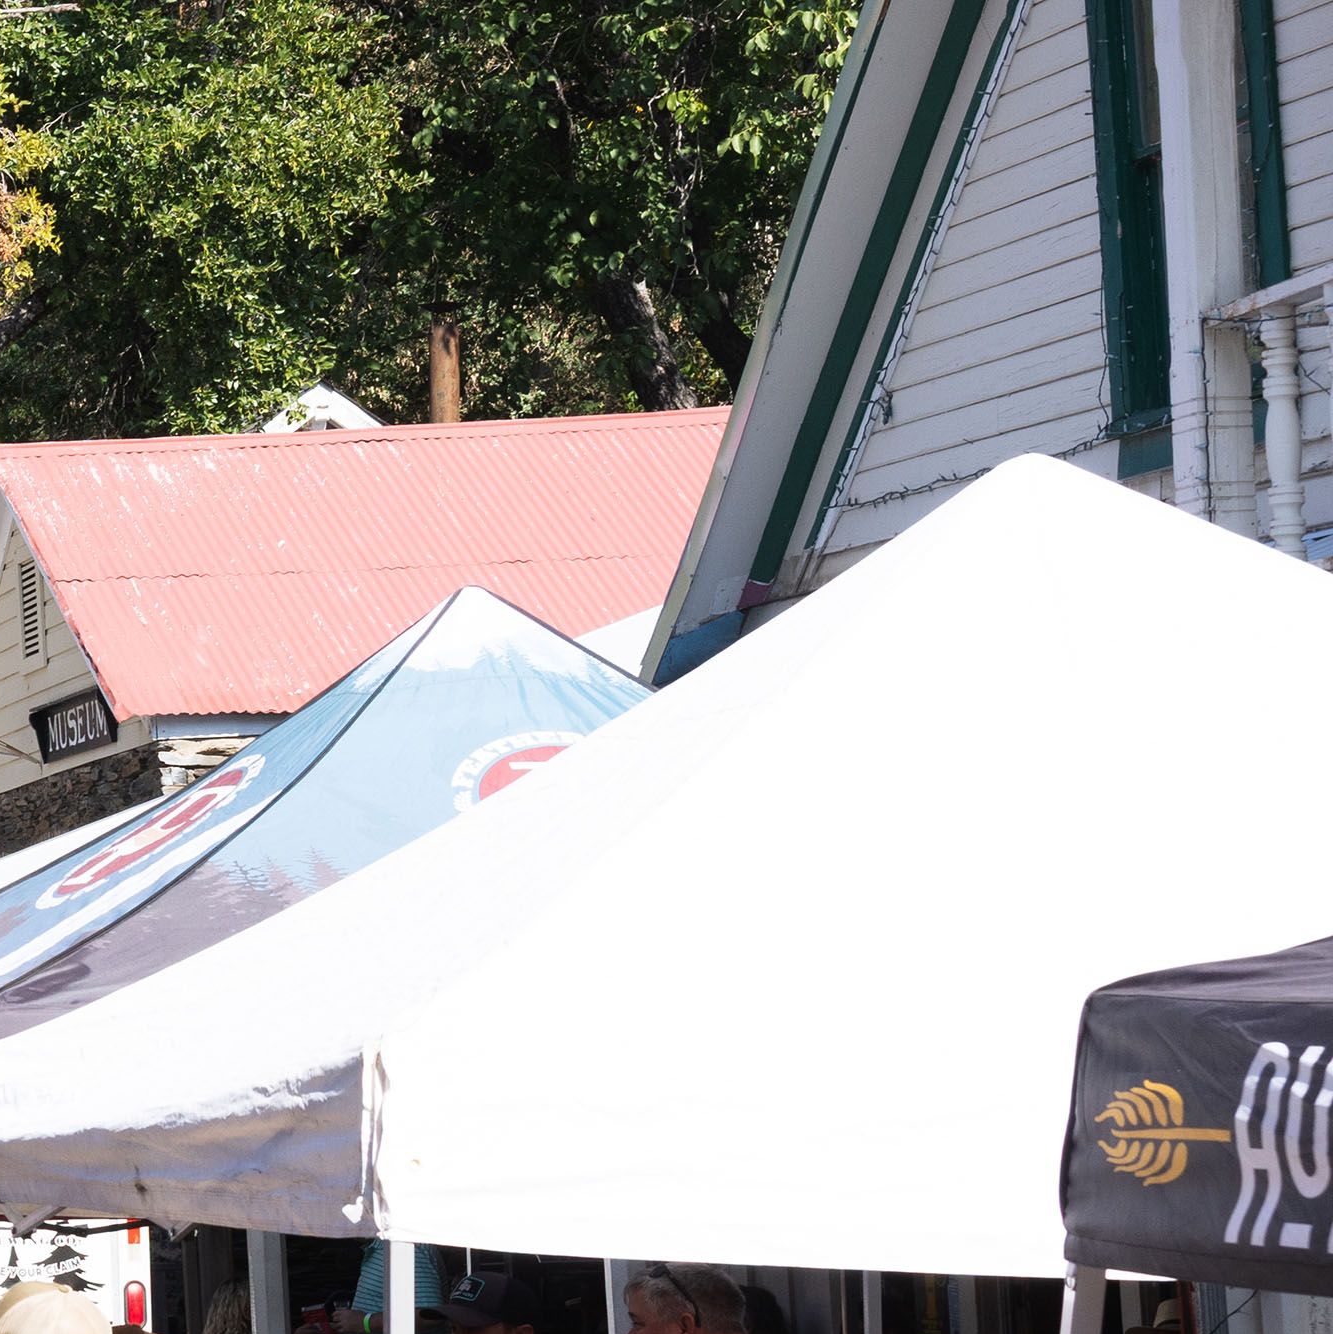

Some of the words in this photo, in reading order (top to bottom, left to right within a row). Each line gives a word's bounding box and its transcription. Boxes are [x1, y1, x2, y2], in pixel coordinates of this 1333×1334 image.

[47, 699, 108, 753] MUSEUM
[8, 1268, 42, 1278] YOUR
[45, 1257, 82, 1276] CLAIM
